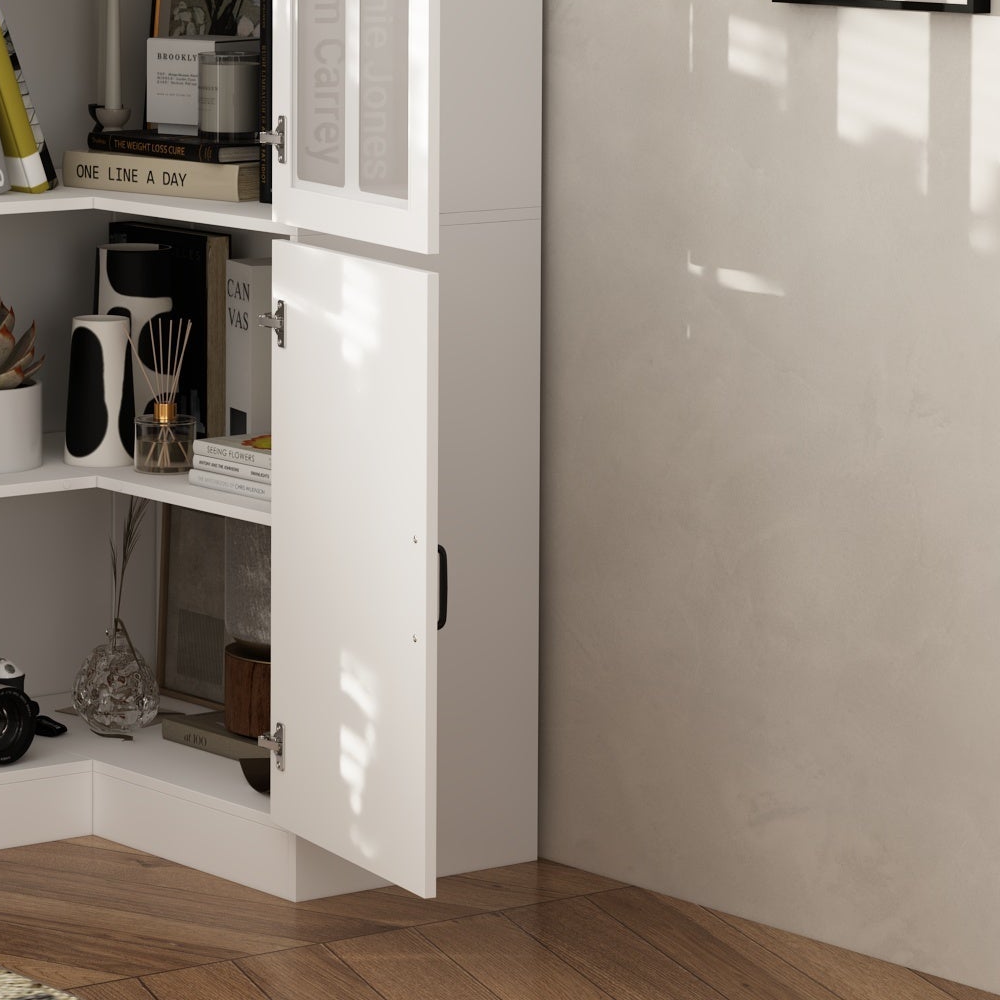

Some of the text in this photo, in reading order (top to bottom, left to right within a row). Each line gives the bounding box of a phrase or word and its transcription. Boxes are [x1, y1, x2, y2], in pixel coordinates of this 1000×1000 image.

[157, 52, 198, 62] BROOKLY
[114, 140, 126, 148] THE
[127, 141, 151, 152] WEIGHT
[152, 144, 168, 154] LOSS
[168, 146, 184, 156] CURE
[76, 164, 187, 187] ONE LINE A DAY
[228, 278, 250, 302] CAN
[228, 308, 249, 332] VAS
[207, 446, 255, 462] SEEING FLOWERS
